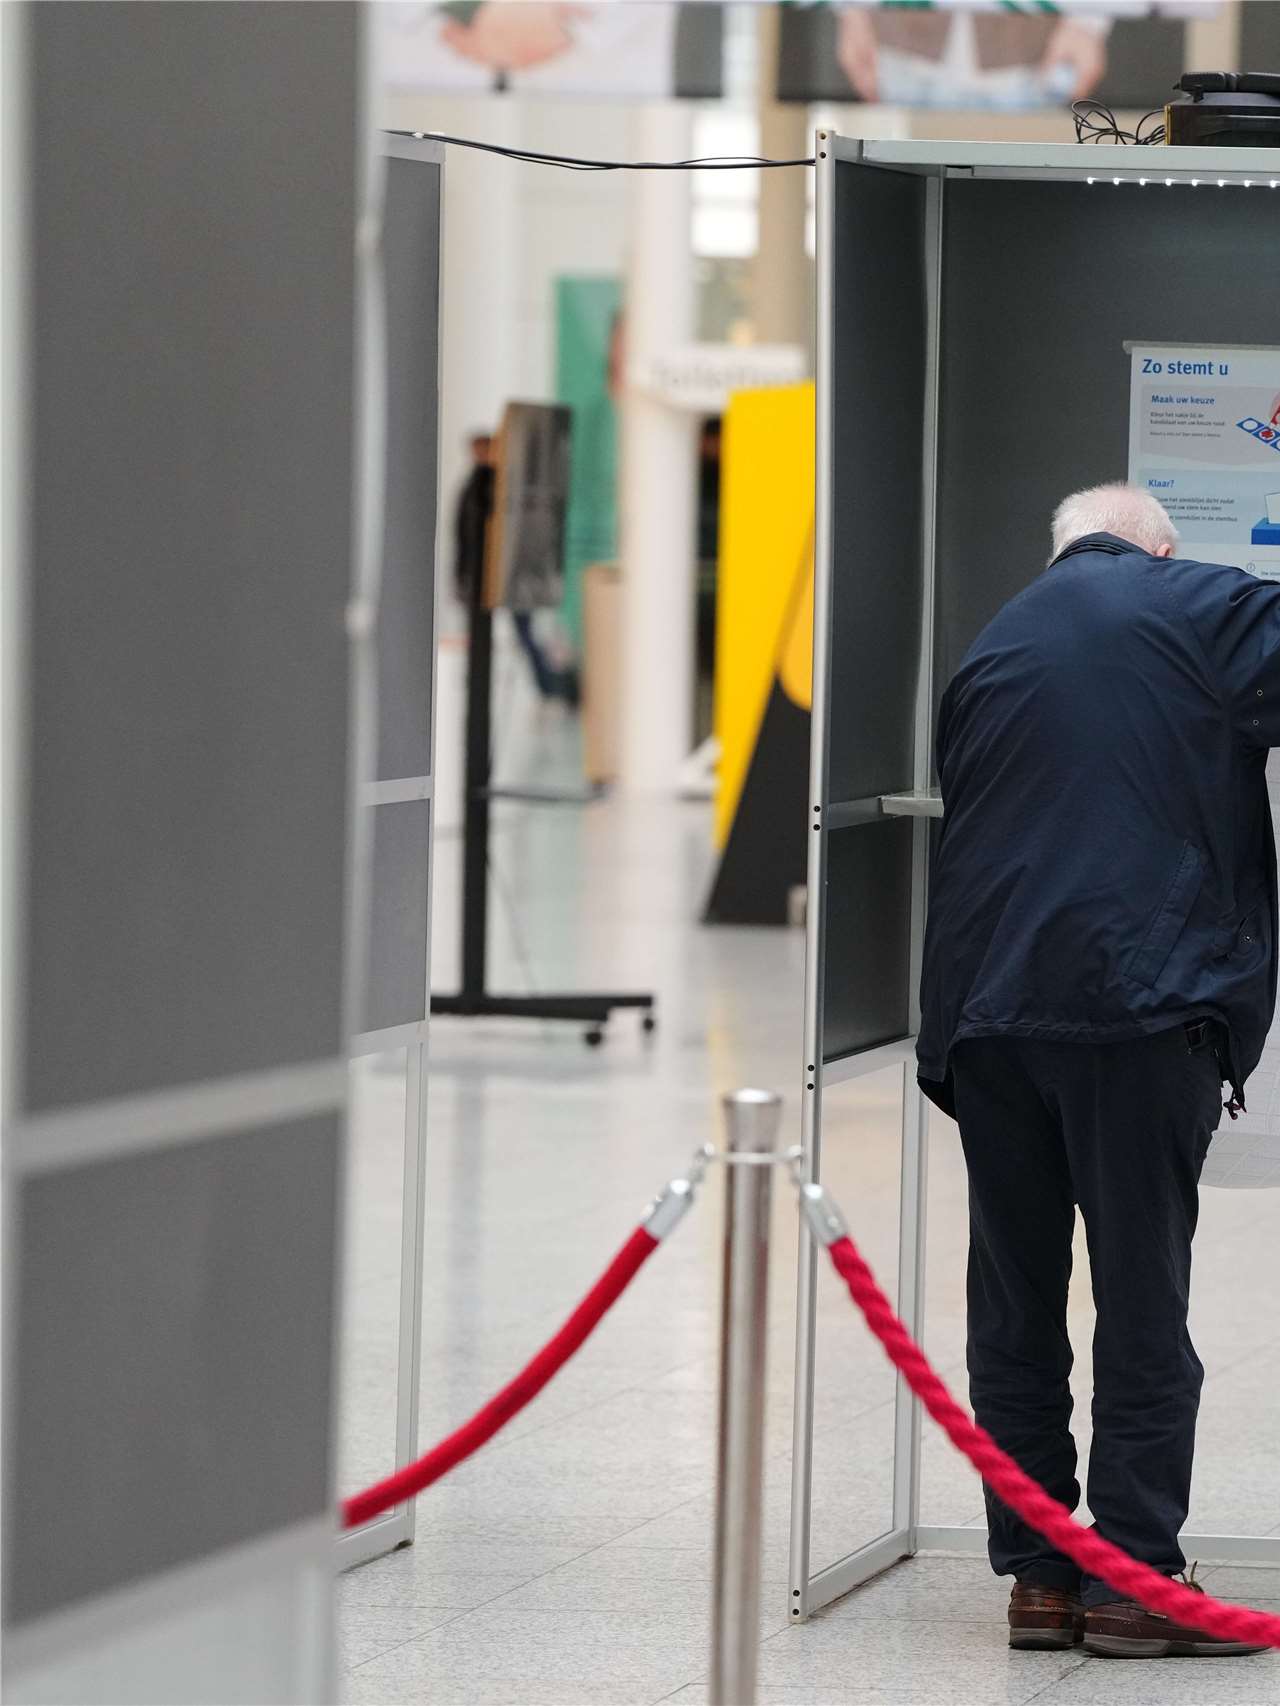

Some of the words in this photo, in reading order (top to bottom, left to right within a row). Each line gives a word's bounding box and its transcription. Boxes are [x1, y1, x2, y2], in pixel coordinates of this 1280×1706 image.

[1142, 358, 1163, 374] Zo
[1168, 360, 1215, 376] stemt
[1219, 364, 1229, 376] u
[1151, 395, 1174, 404] Maak
[1190, 396, 1215, 405] keuze
[1148, 479, 1175, 488] Klaar?
